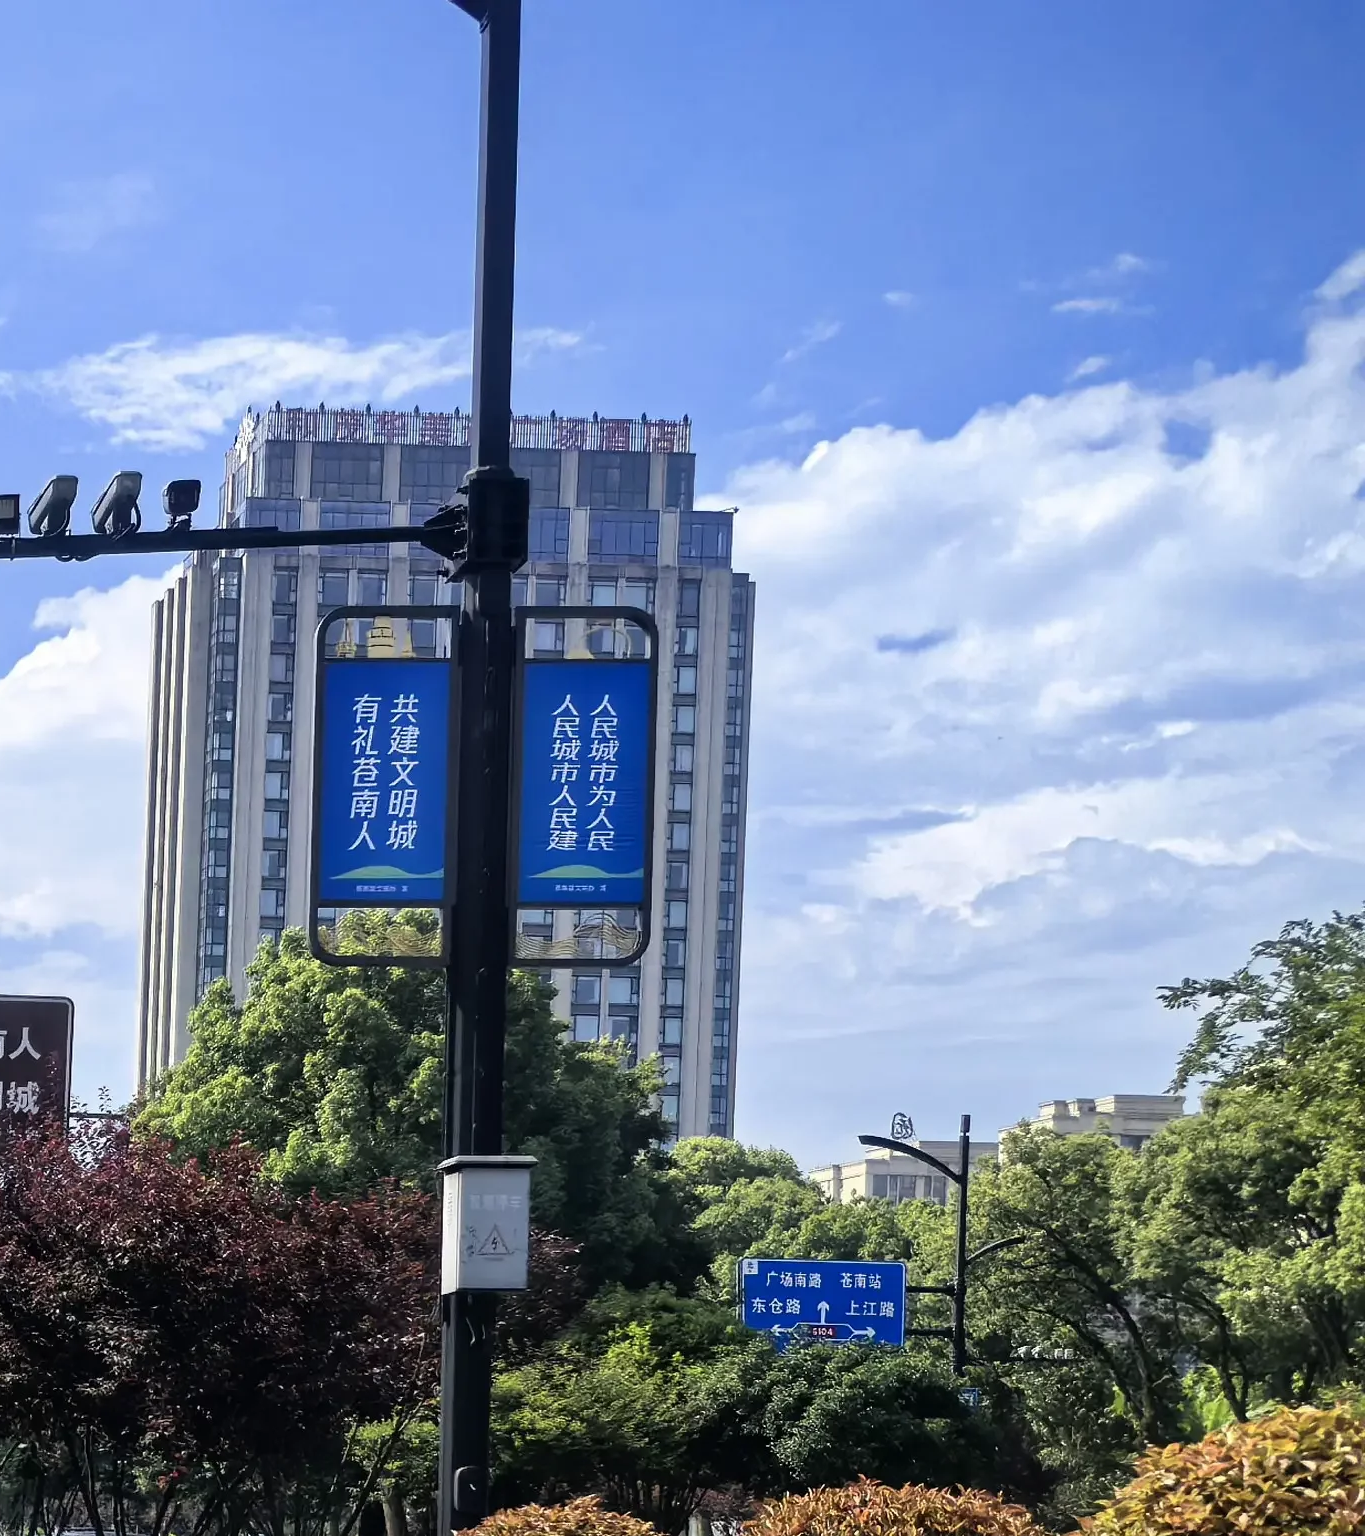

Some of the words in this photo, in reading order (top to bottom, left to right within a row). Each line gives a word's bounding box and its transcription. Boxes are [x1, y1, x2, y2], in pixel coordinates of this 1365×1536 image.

[347, 693, 382, 851] 有礼苍南人
[386, 693, 420, 851] 共建文明城
[546, 693, 581, 852] 人民城市人民建
[585, 693, 619, 852] 人民城市为人民
[751, 1297, 801, 1315] 东仓路
[844, 1300, 895, 1318] 上江路
[765, 1270, 822, 1288] 广场南路
[839, 1272, 882, 1289] 苍南站
